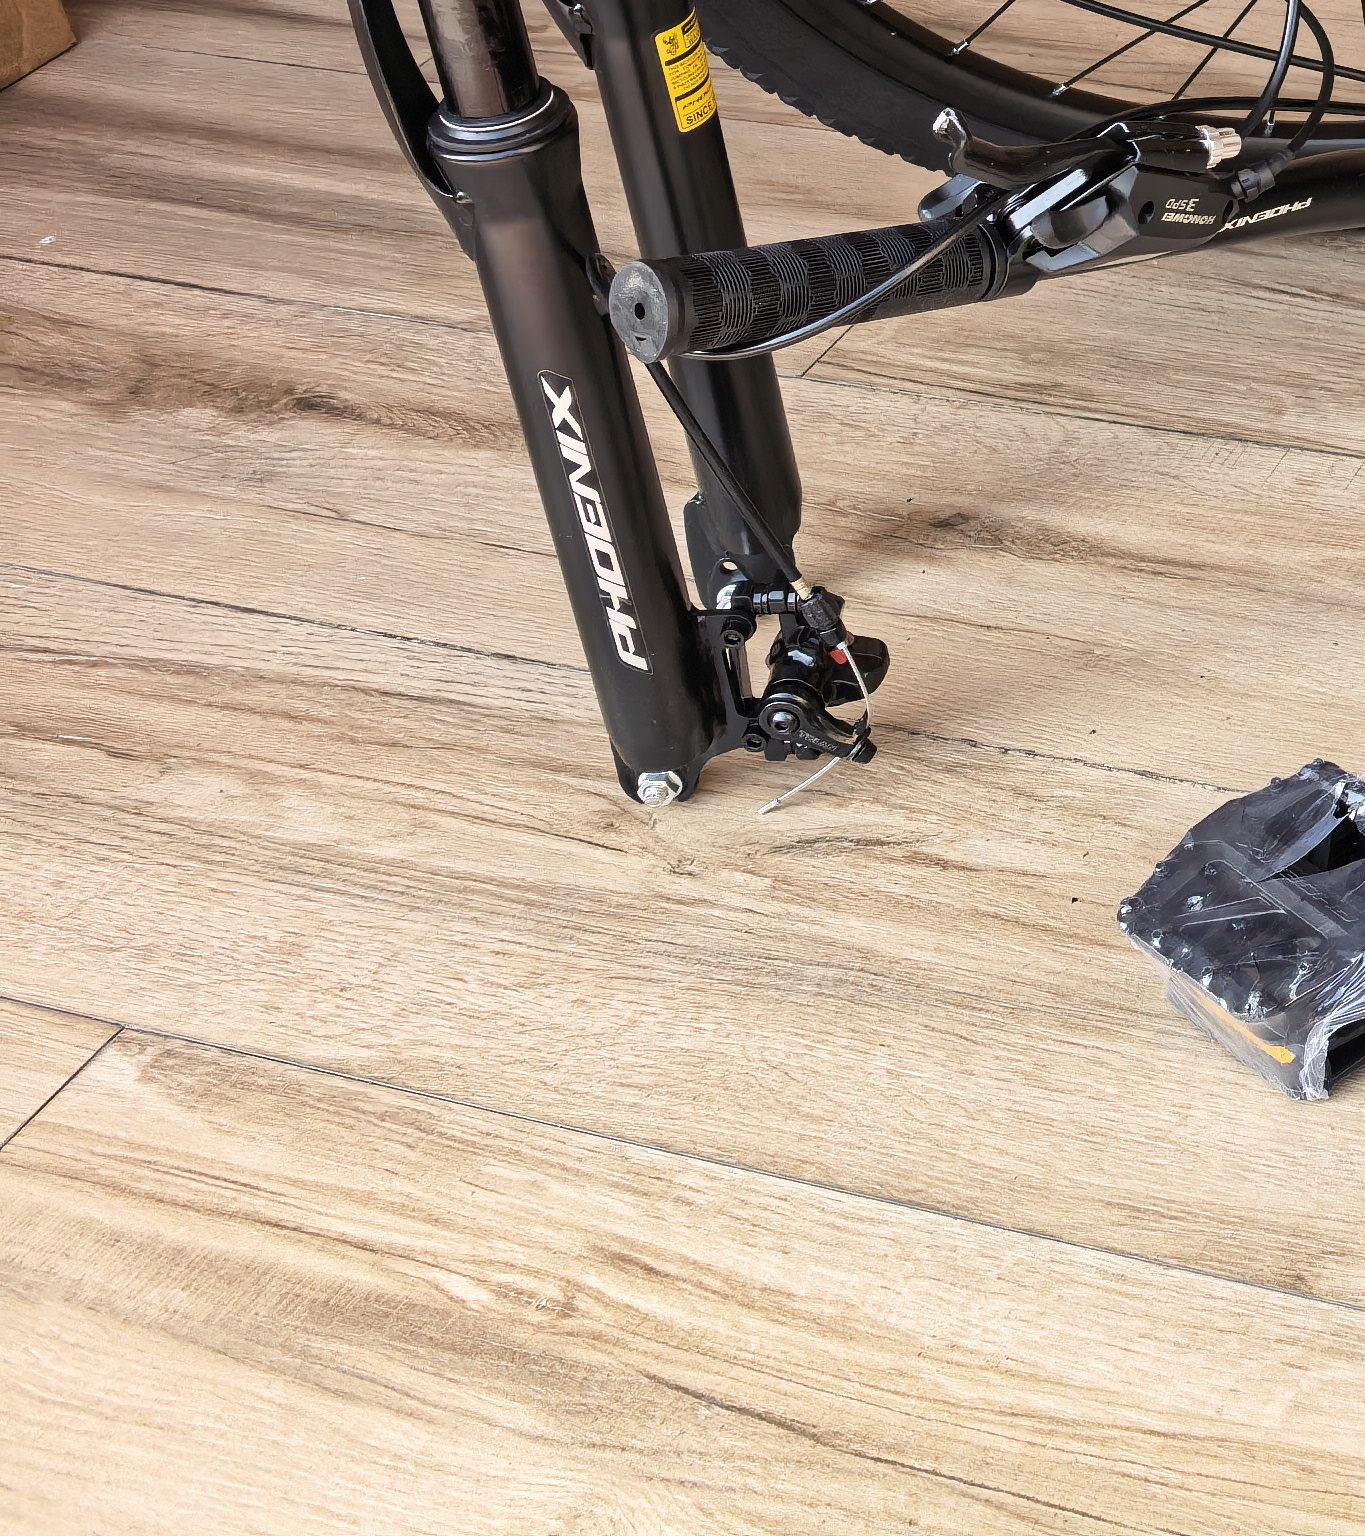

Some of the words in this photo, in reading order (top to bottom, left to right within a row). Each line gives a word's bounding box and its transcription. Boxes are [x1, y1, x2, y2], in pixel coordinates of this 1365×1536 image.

[686, 100, 713, 125] SINCE
[1218, 197, 1312, 233] PHOENIX
[540, 375, 649, 671] PHOENIX
